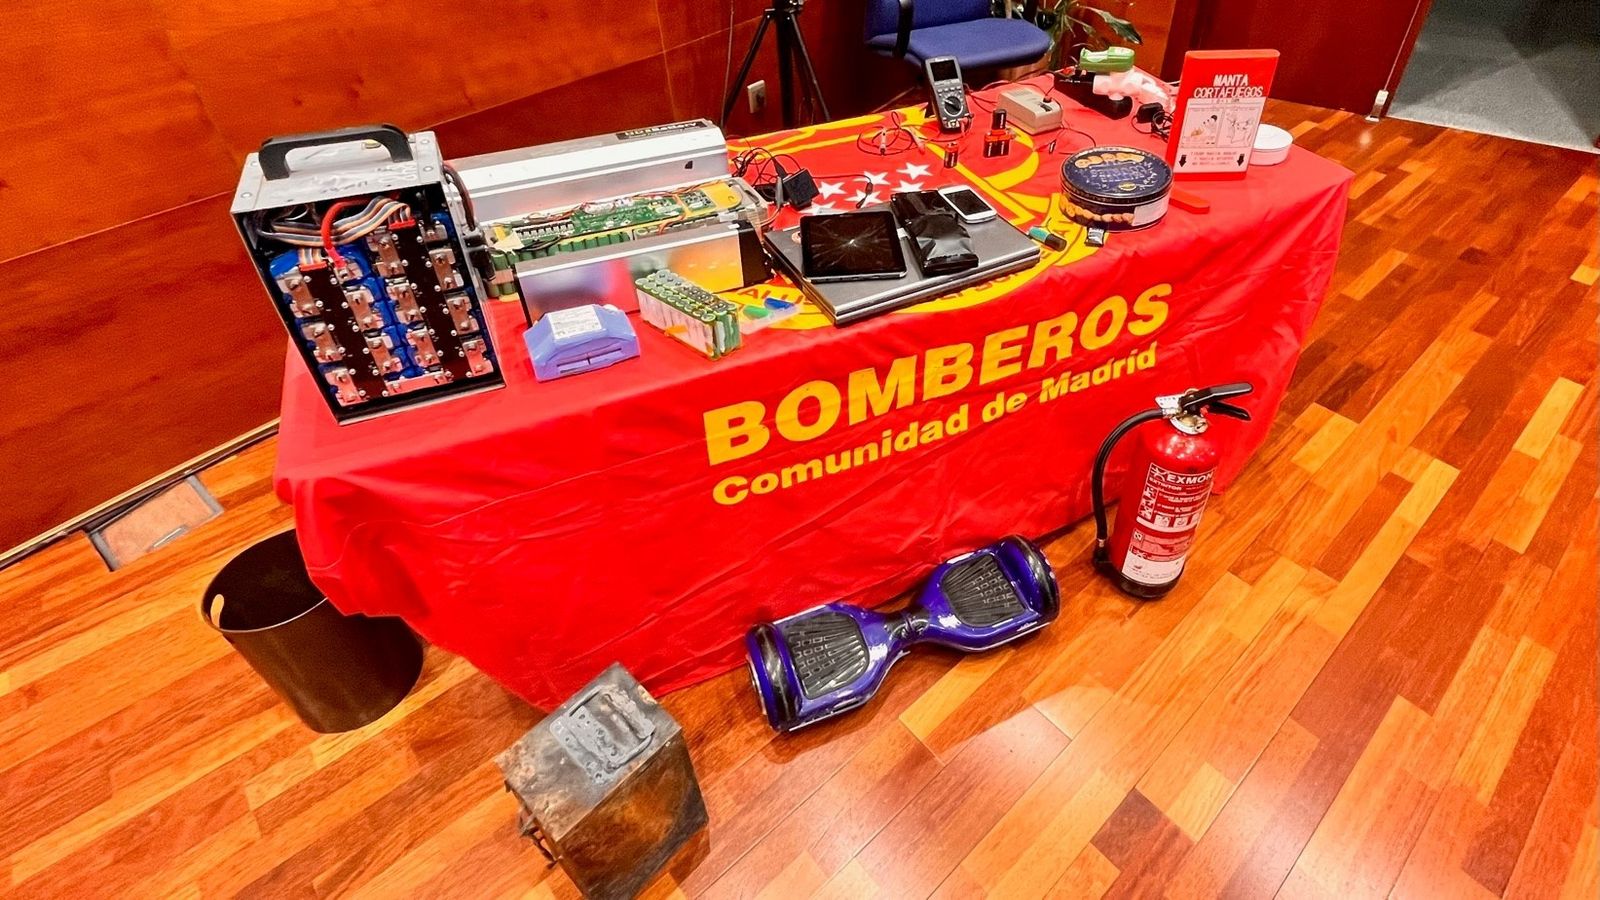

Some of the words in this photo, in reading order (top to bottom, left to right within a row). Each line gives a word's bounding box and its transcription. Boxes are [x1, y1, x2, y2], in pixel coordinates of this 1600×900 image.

[1193, 86, 1264, 99] CORTAFUEGOS
[1213, 74, 1249, 87] MANTA
[703, 283, 1173, 467] BOMBEROS
[712, 403, 969, 506] Comunidad
[981, 392, 1028, 424] de
[1039, 341, 1158, 405] Madrid
